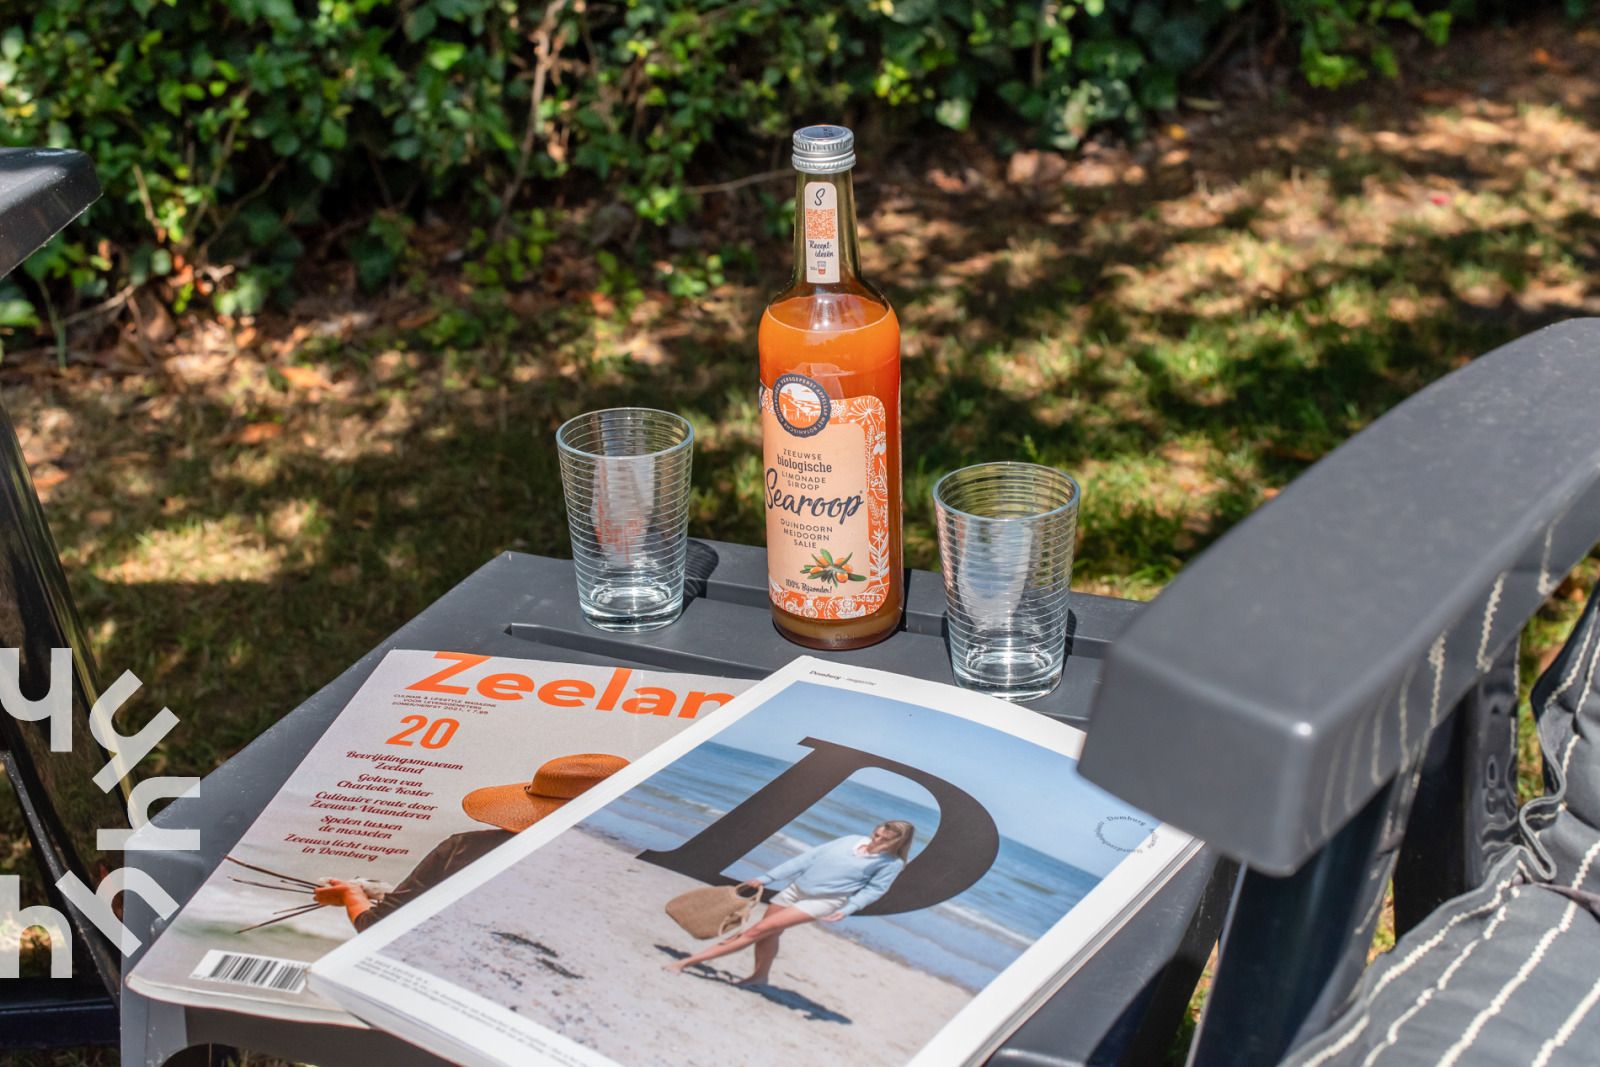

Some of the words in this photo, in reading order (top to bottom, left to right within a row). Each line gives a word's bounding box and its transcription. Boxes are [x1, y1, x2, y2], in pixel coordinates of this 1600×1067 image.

[783, 449, 822, 460] ZEEUWSE
[777, 454, 832, 474] biologische
[781, 471, 826, 483] LIMONADE
[787, 480, 820, 490] SIROOP
[765, 467, 864, 525] Searoop
[780, 518, 833, 532] DUINDOORN
[794, 539, 817, 549] SALIE
[385, 714, 460, 749] 20
[346, 751, 464, 770] Bevrijdingsmuseum
[374, 762, 425, 775] Zeeland
[357, 773, 394, 785] Golven
[398, 779, 424, 788] van
[337, 780, 393, 793] Charlotte
[395, 787, 434, 798] Koster
[315, 791, 370, 804] Culinaire
[373, 798, 402, 808] route
[407, 801, 438, 811] door
[320, 815, 360, 827] Spelen
[363, 820, 402, 831] tussen
[318, 824, 333, 833] de
[337, 827, 393, 839] mosselen
[284, 833, 330, 846] Zeeuws
[331, 839, 361, 849] licht
[362, 844, 409, 855] vangen
[302, 845, 315, 854] in
[318, 847, 379, 862] Domburg
